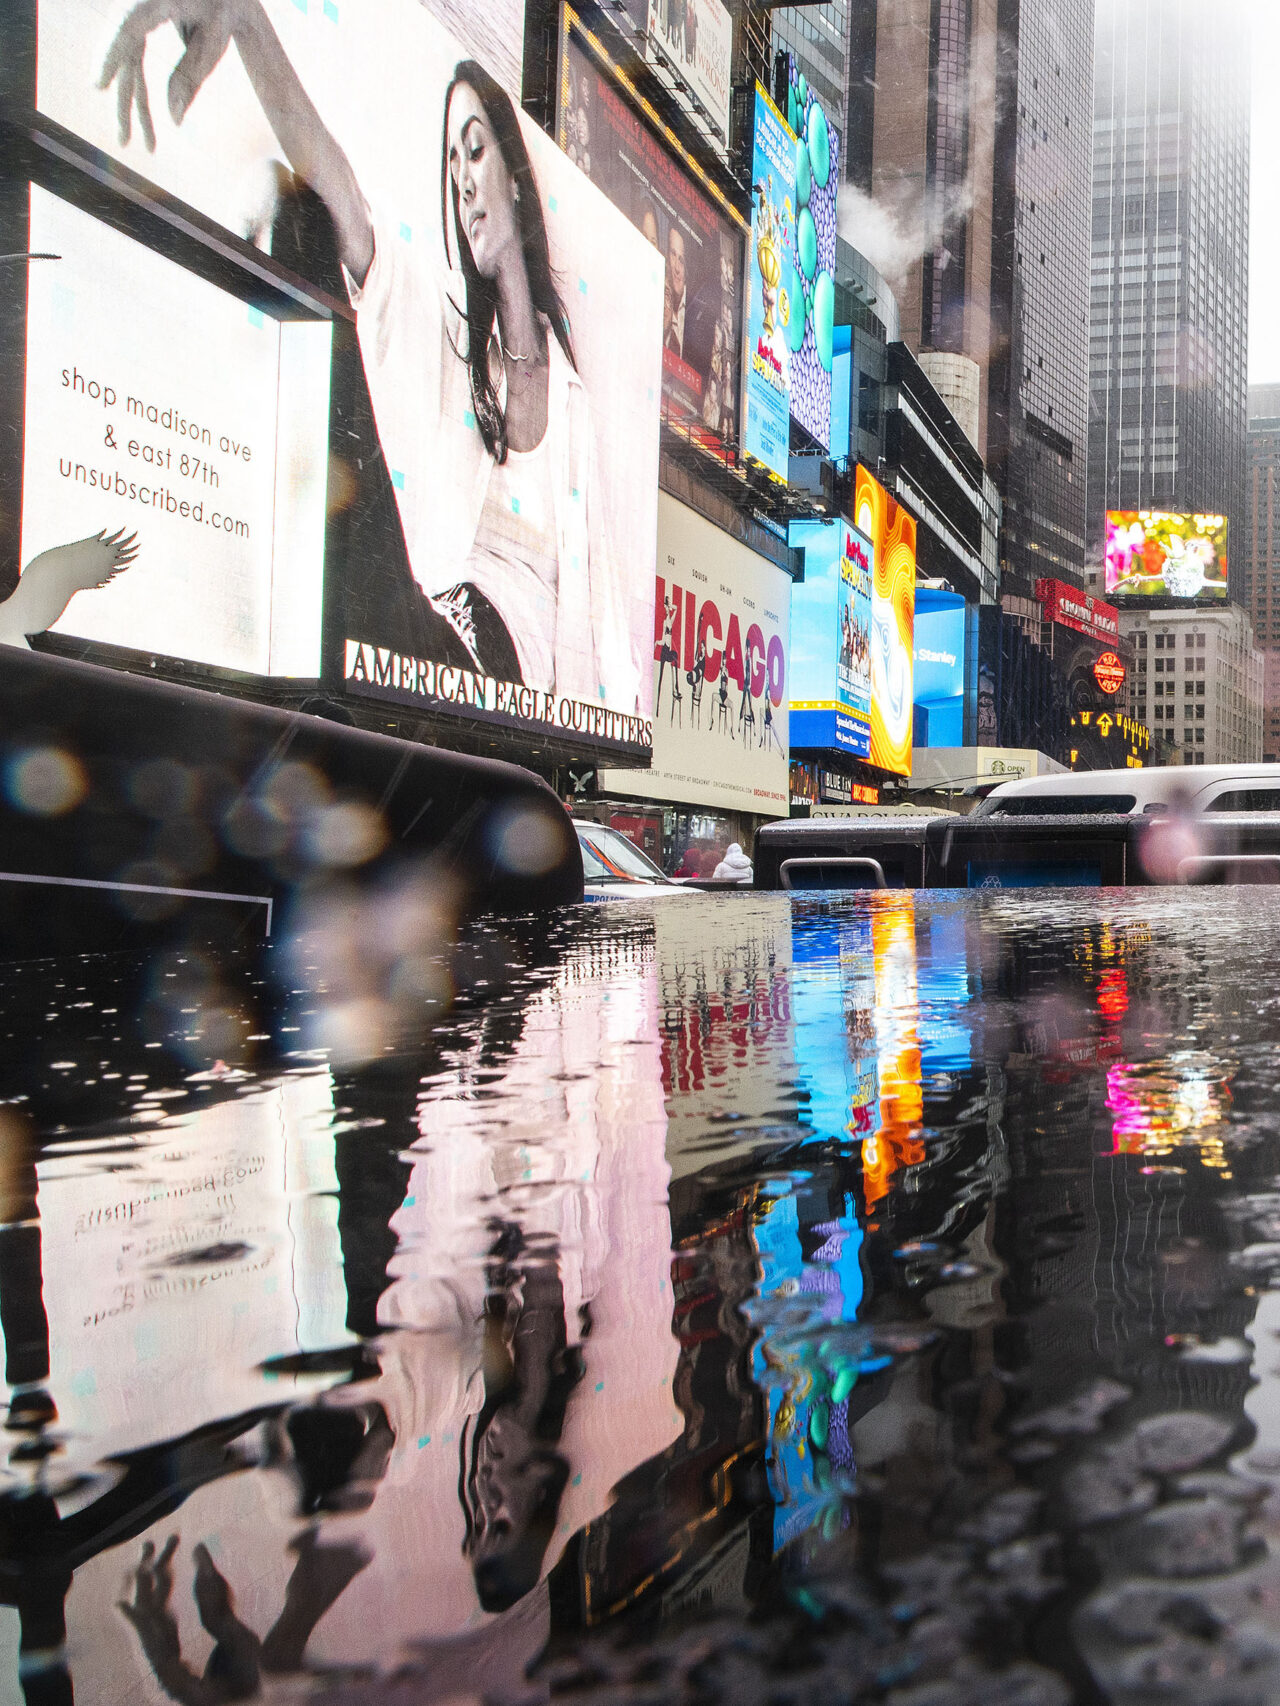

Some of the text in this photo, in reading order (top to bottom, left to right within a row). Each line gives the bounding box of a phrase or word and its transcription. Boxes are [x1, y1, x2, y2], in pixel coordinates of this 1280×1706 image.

[61, 367, 251, 462] shop madison ave
[104, 424, 219, 489] & east 87th
[59, 458, 250, 539] unsubscribed.com
[667, 555, 675, 566] SIX
[692, 568, 708, 583] SQUISH
[743, 597, 756, 610] CICERO
[653, 575, 785, 708] HICAGO
[918, 648, 956, 667] Stanley
[352, 642, 652, 747] AMERICAN EAGLE OUTFITTERS
